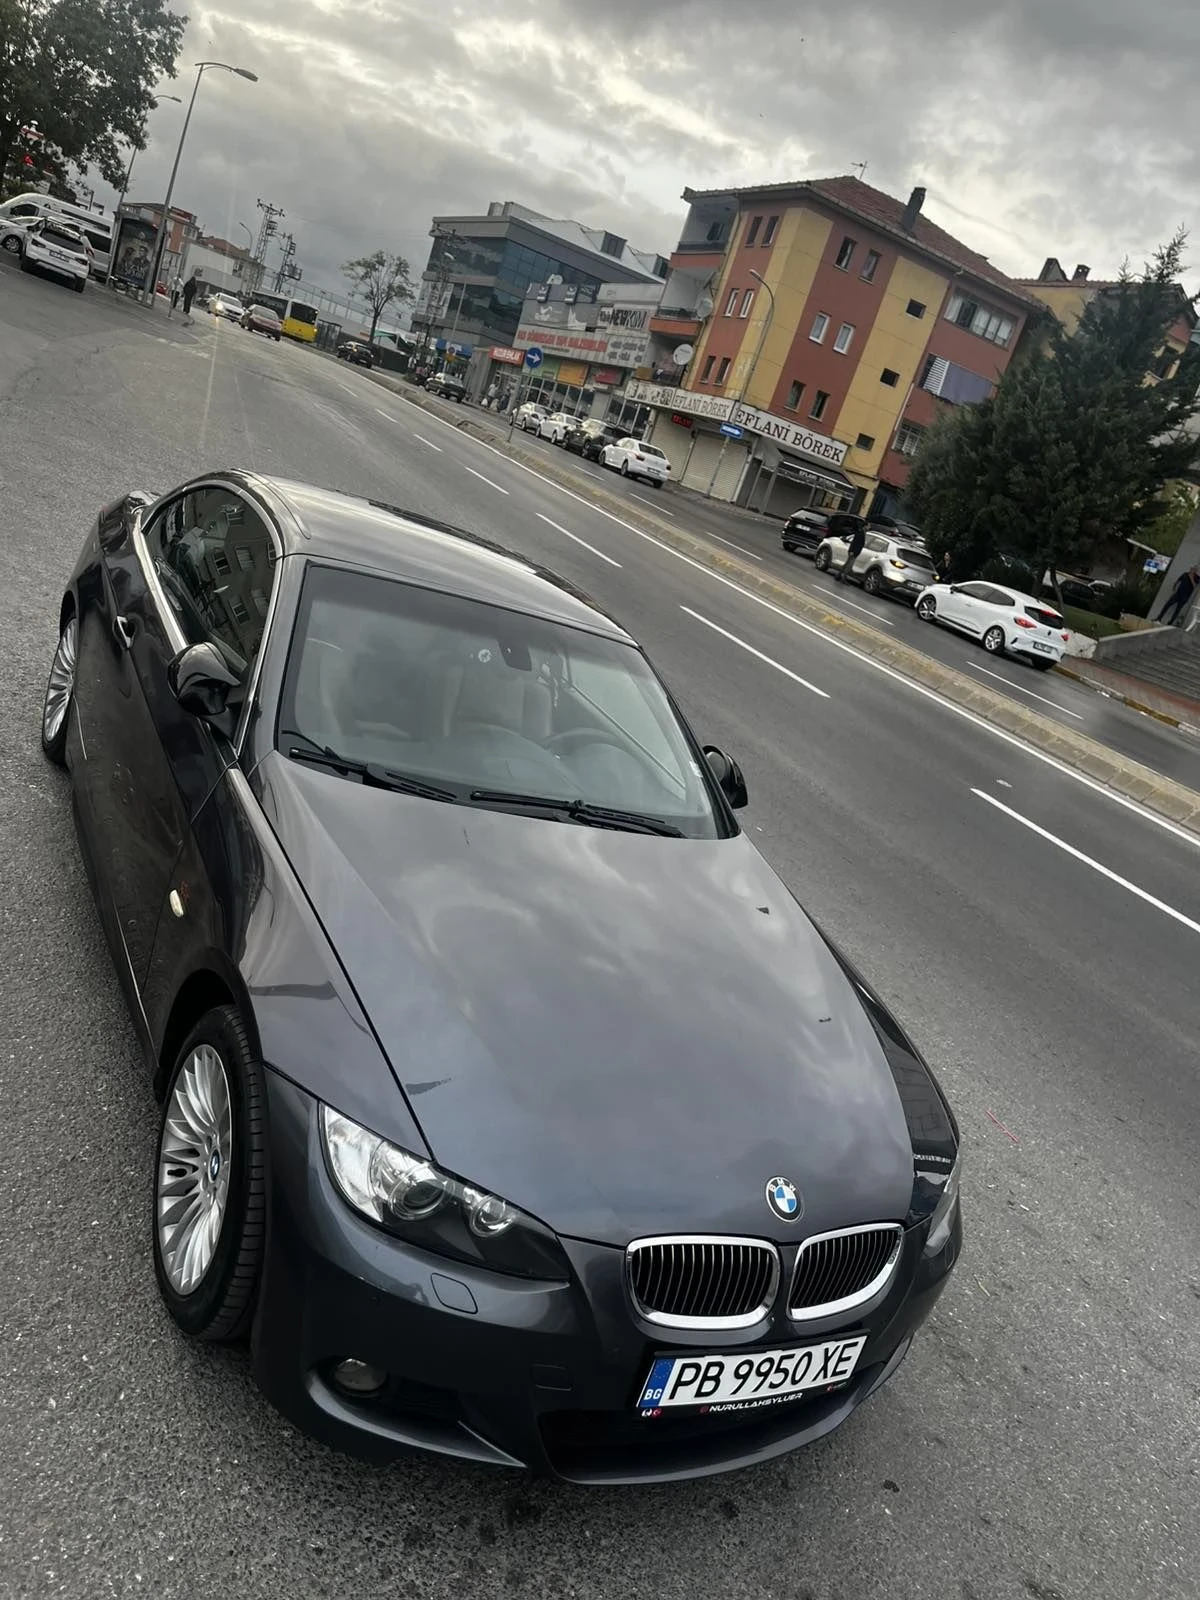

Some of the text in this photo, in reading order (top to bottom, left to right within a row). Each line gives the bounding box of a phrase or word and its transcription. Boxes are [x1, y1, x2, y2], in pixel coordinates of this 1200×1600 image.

[734, 410, 844, 463] EFLANİ BÖREK
[644, 1387, 662, 1400] BG
[669, 1341, 859, 1400] PB 9950 XE
